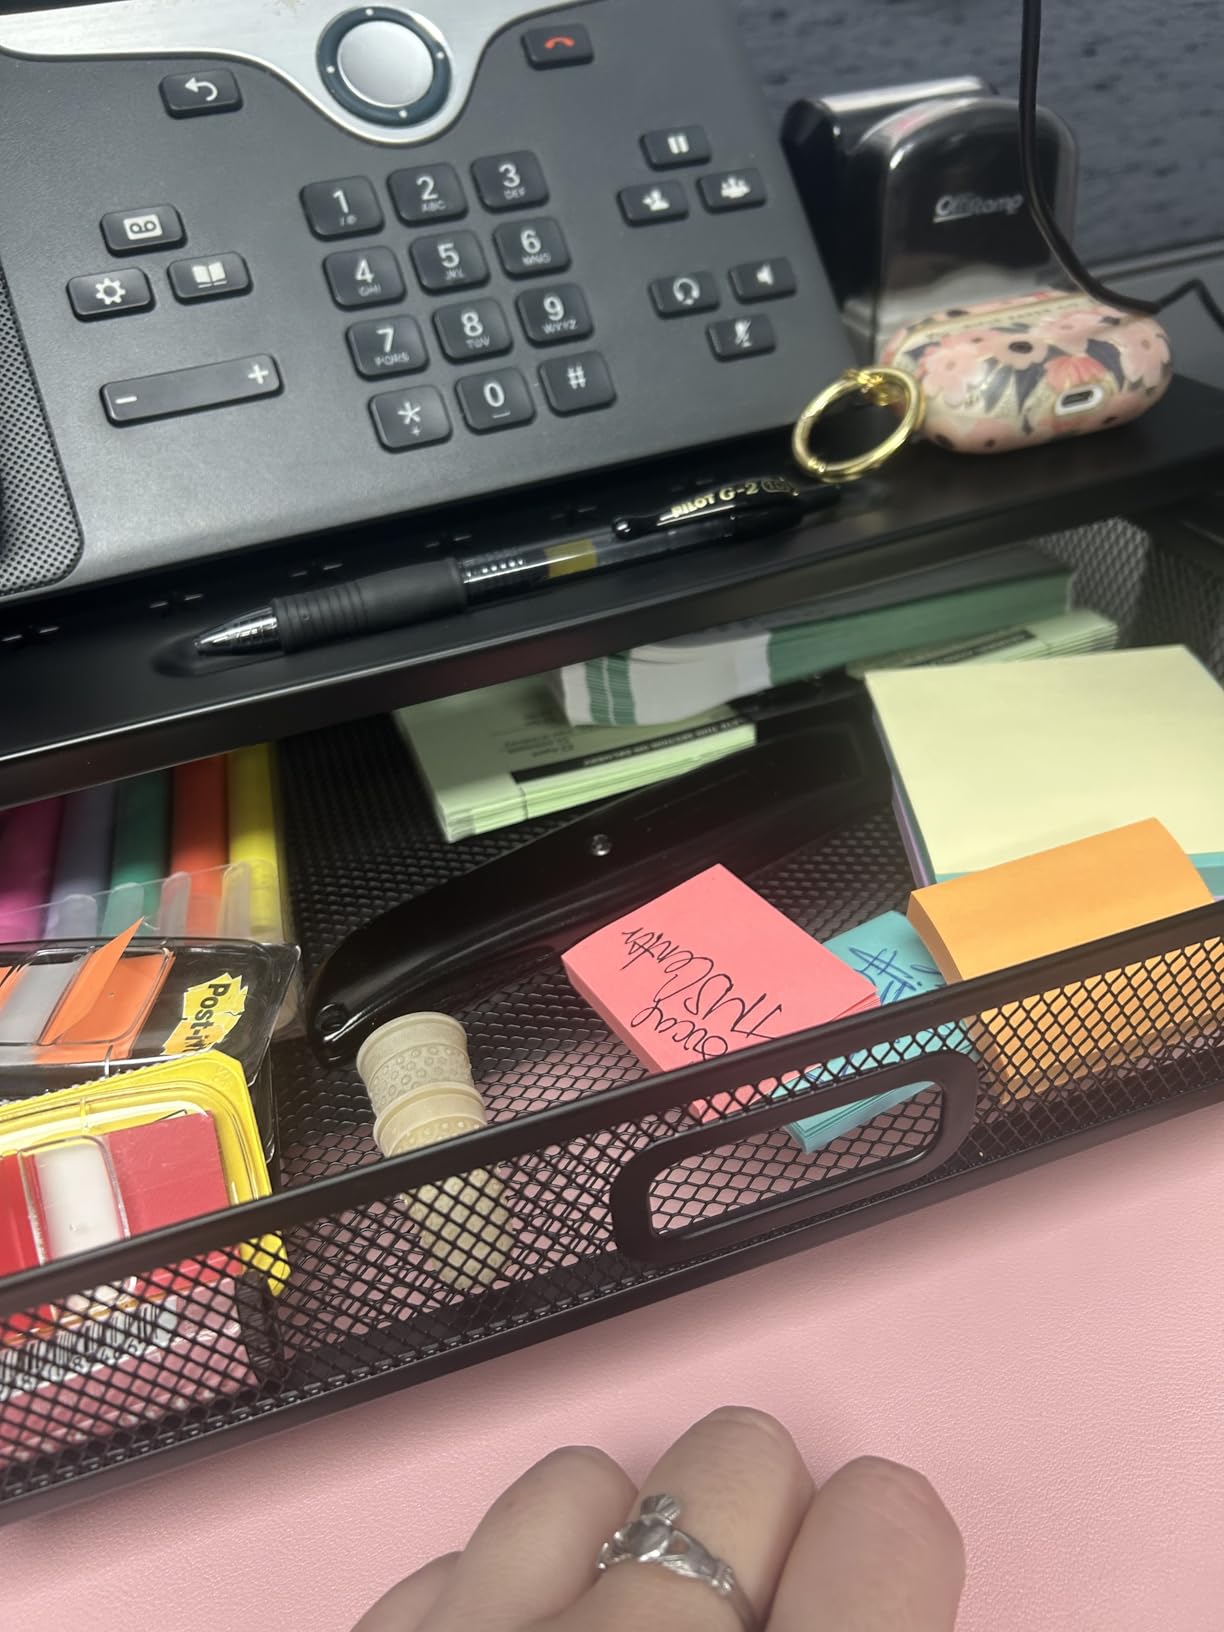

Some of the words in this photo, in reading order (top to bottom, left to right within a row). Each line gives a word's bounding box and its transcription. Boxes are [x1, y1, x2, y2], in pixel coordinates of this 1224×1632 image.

[416, 176, 438, 200] 2
[499, 163, 521, 188] 3
[333, 189, 349, 214] 1
[520, 230, 542, 254] 6
[437, 243, 460, 268] 5
[355, 259, 375, 283] 4
[543, 296, 565, 321] 9
[461, 312, 483, 337] 8
[376, 327, 394, 352] 7
[483, 381, 505, 407] 0
[671, 493, 717, 518] PILOT
[719, 480, 759, 501] G-2
